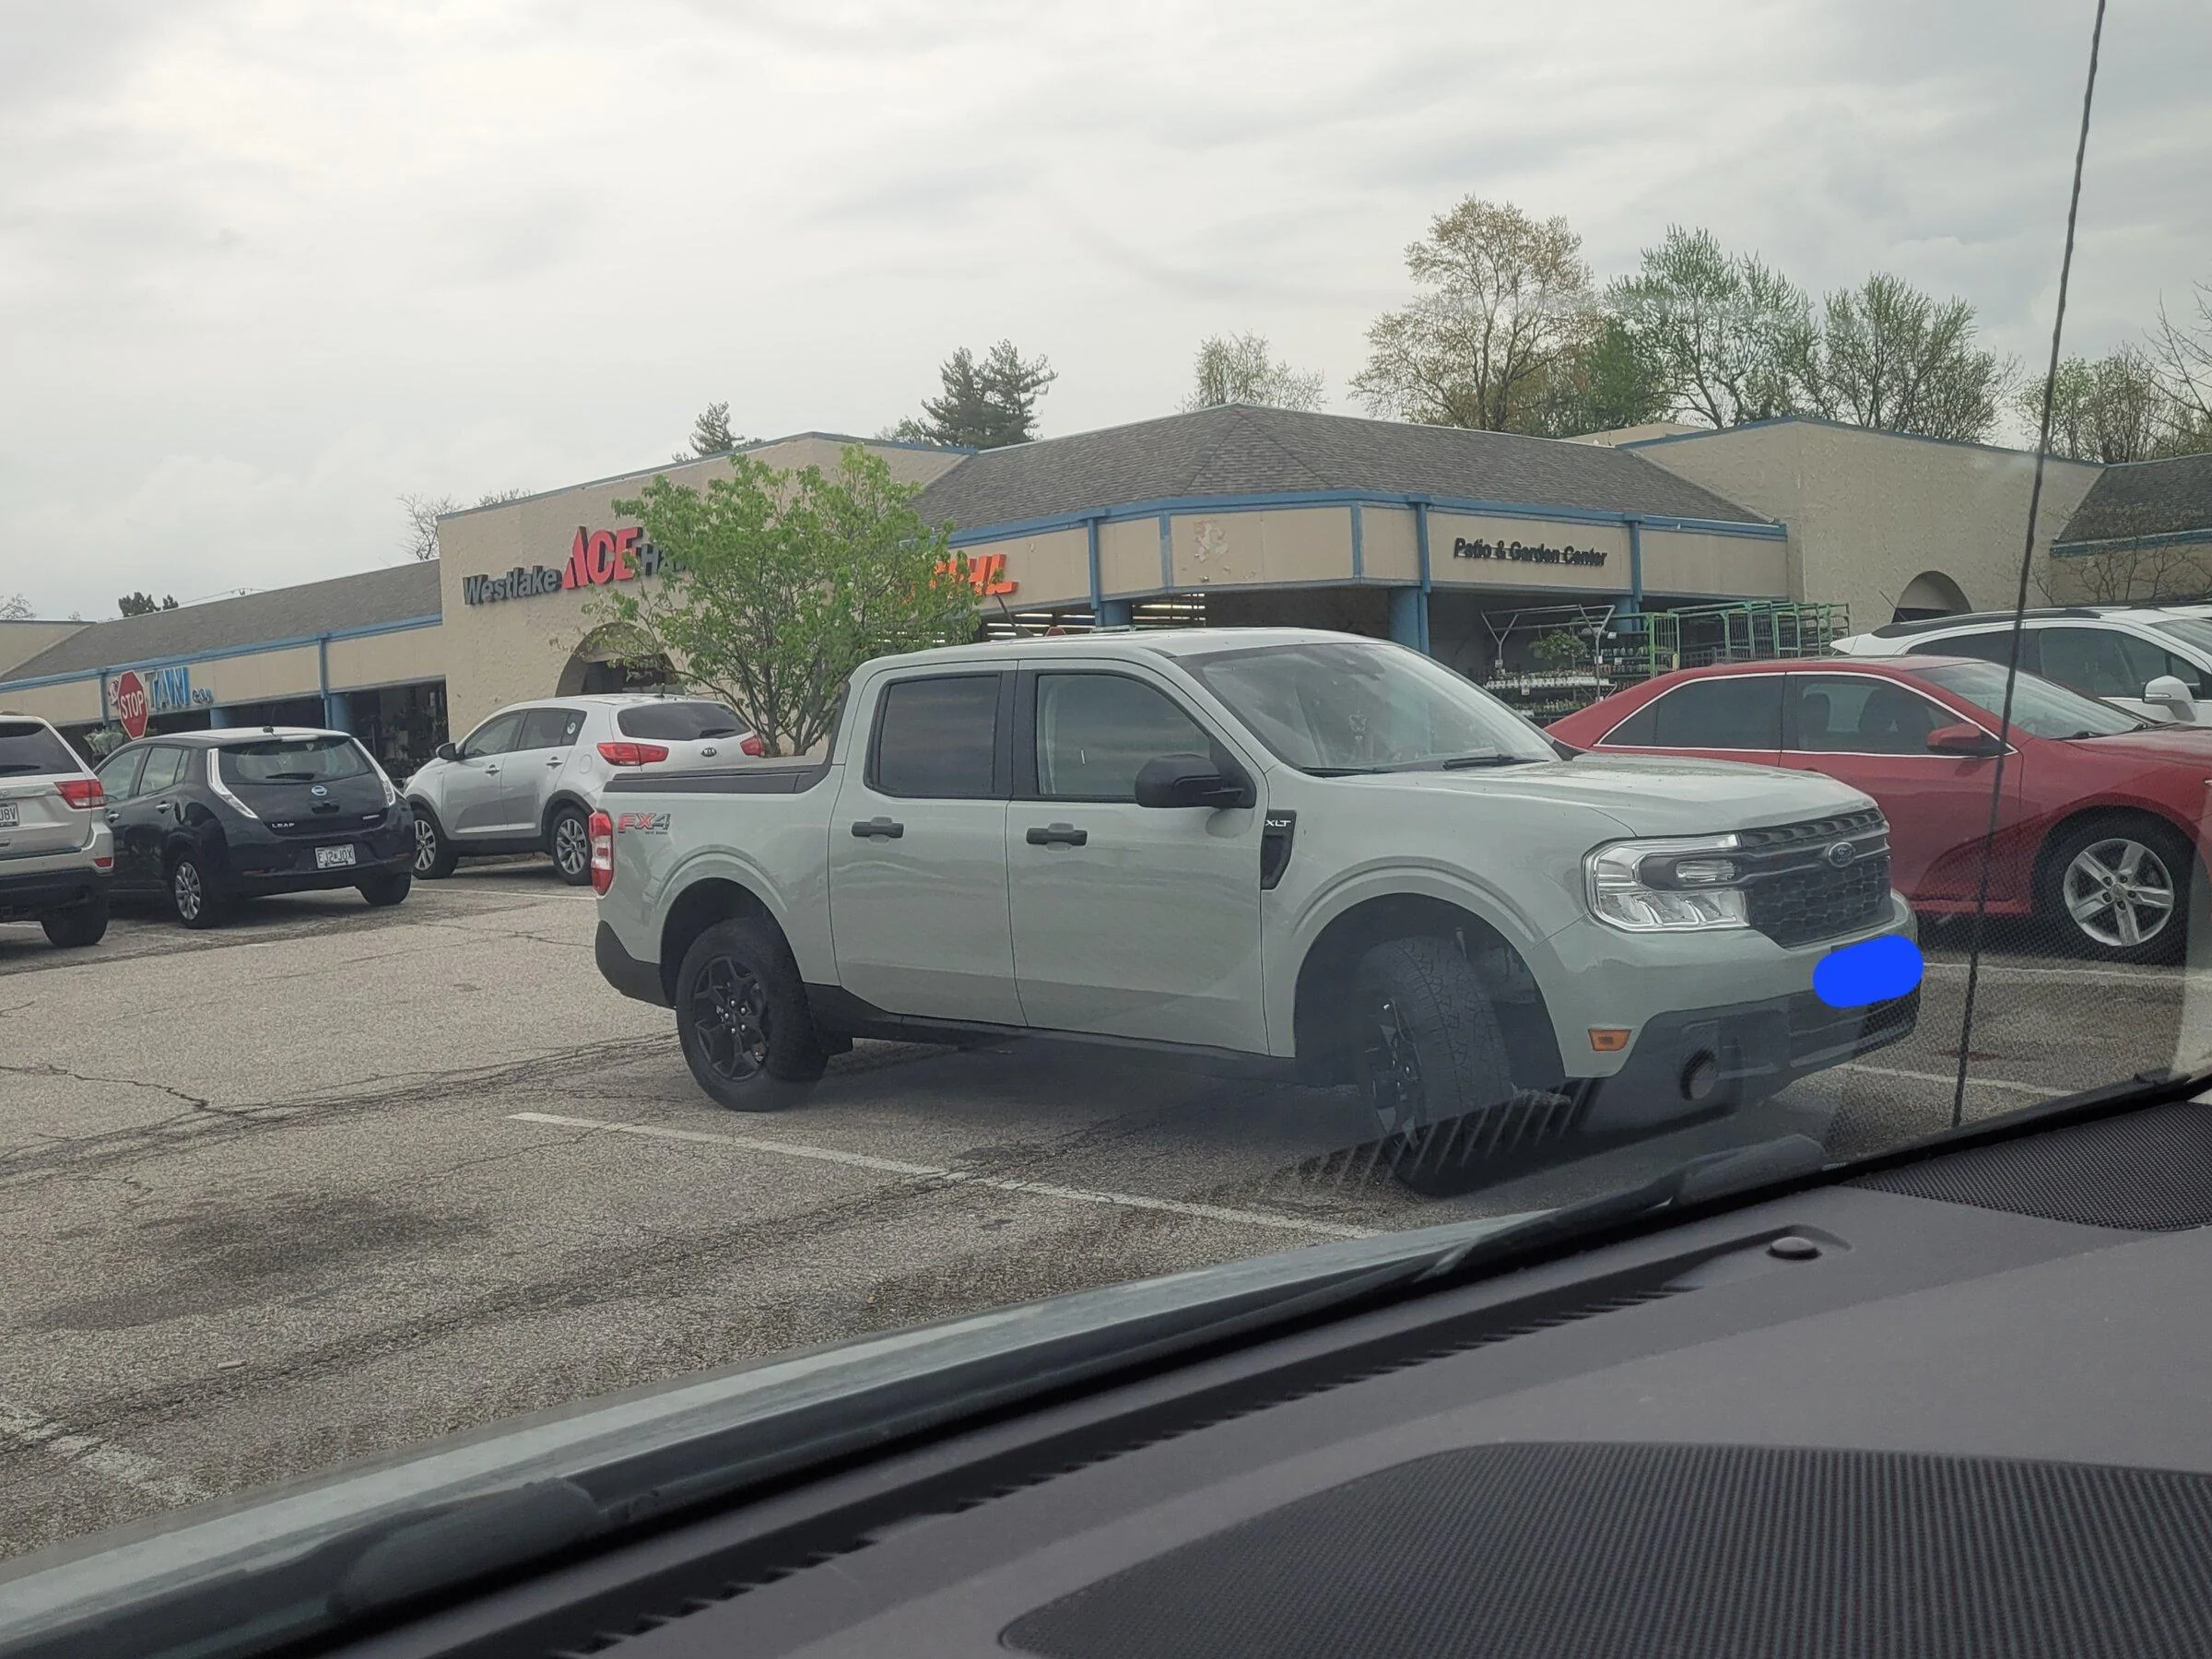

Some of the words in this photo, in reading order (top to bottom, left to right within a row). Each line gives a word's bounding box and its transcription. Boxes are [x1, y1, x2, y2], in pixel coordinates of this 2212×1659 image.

[462, 565, 561, 605] Westlake
[560, 525, 643, 589] ACE
[1454, 537, 1491, 559] Patio
[1511, 541, 1559, 563] Garden
[1564, 546, 1607, 566] Center
[144, 666, 190, 712] TAN
[121, 690, 144, 719] STOP
[618, 813, 671, 833] FX4
